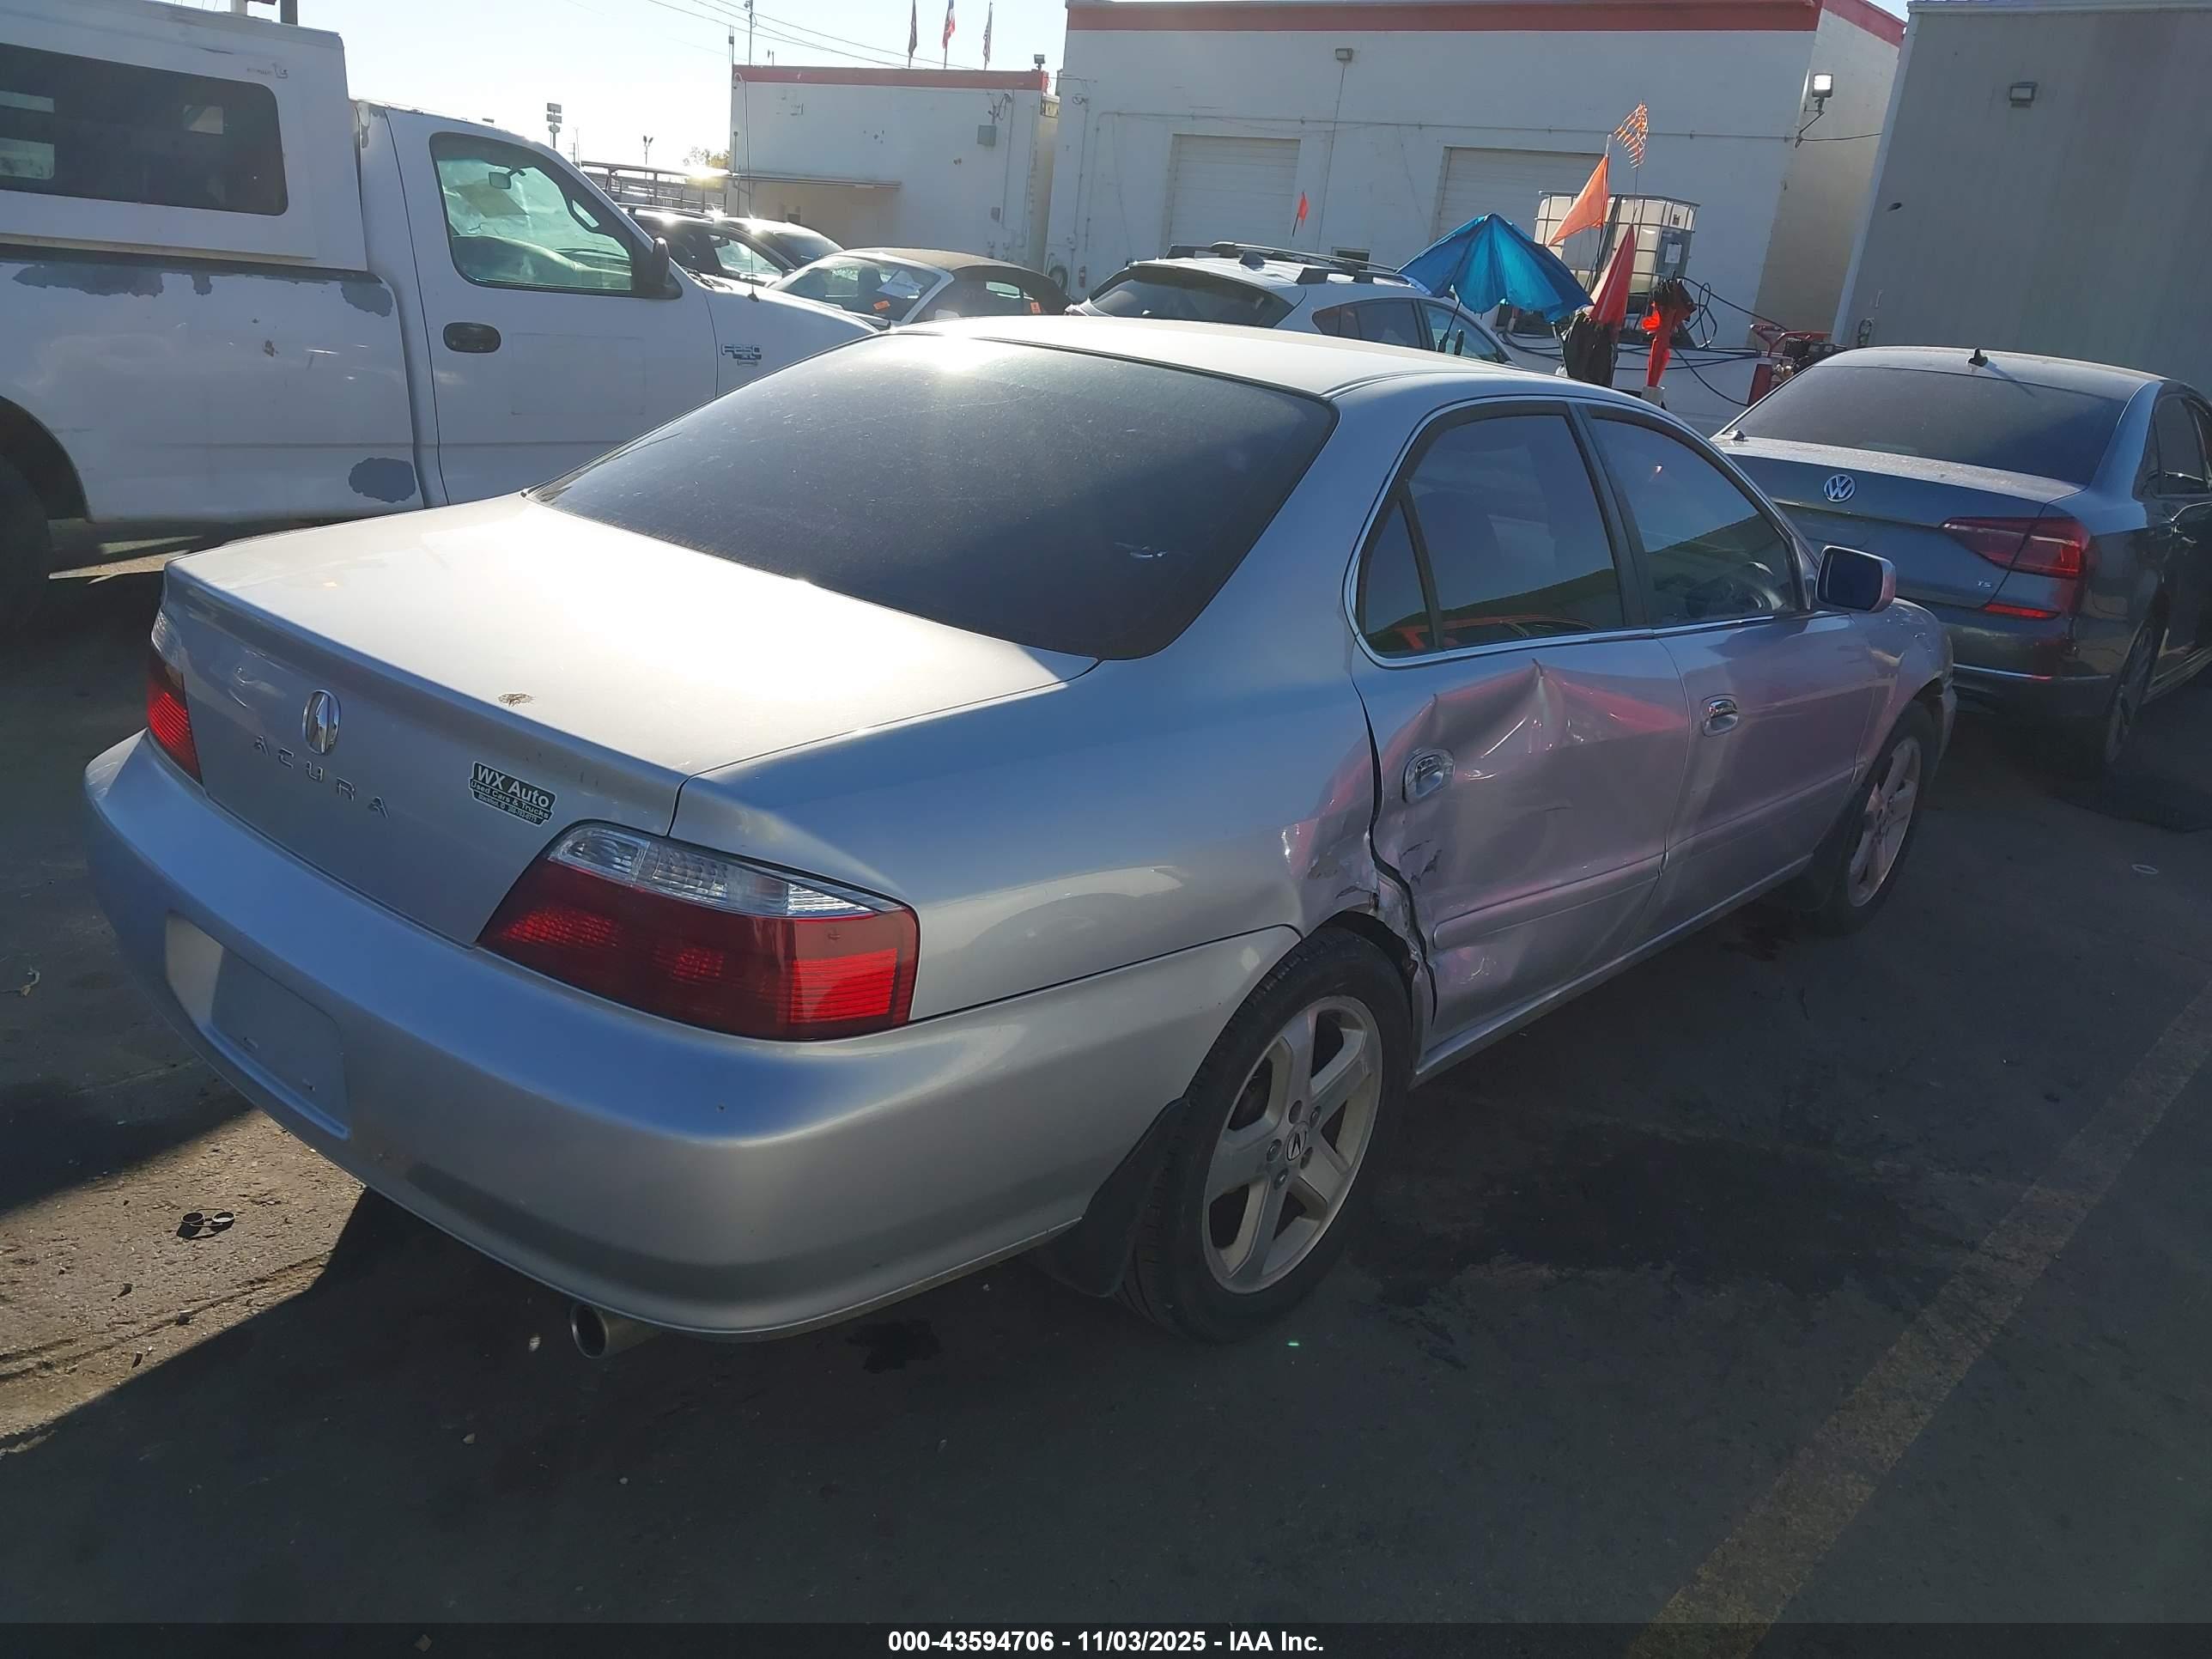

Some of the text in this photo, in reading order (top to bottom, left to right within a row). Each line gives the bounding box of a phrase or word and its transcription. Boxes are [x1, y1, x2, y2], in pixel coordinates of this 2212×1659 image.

[254, 735, 389, 818] ACURA
[477, 765, 550, 807] WX Auto
[471, 781, 490, 793] Used
[492, 790, 511, 803] Cars
[520, 802, 550, 819] Trucks
